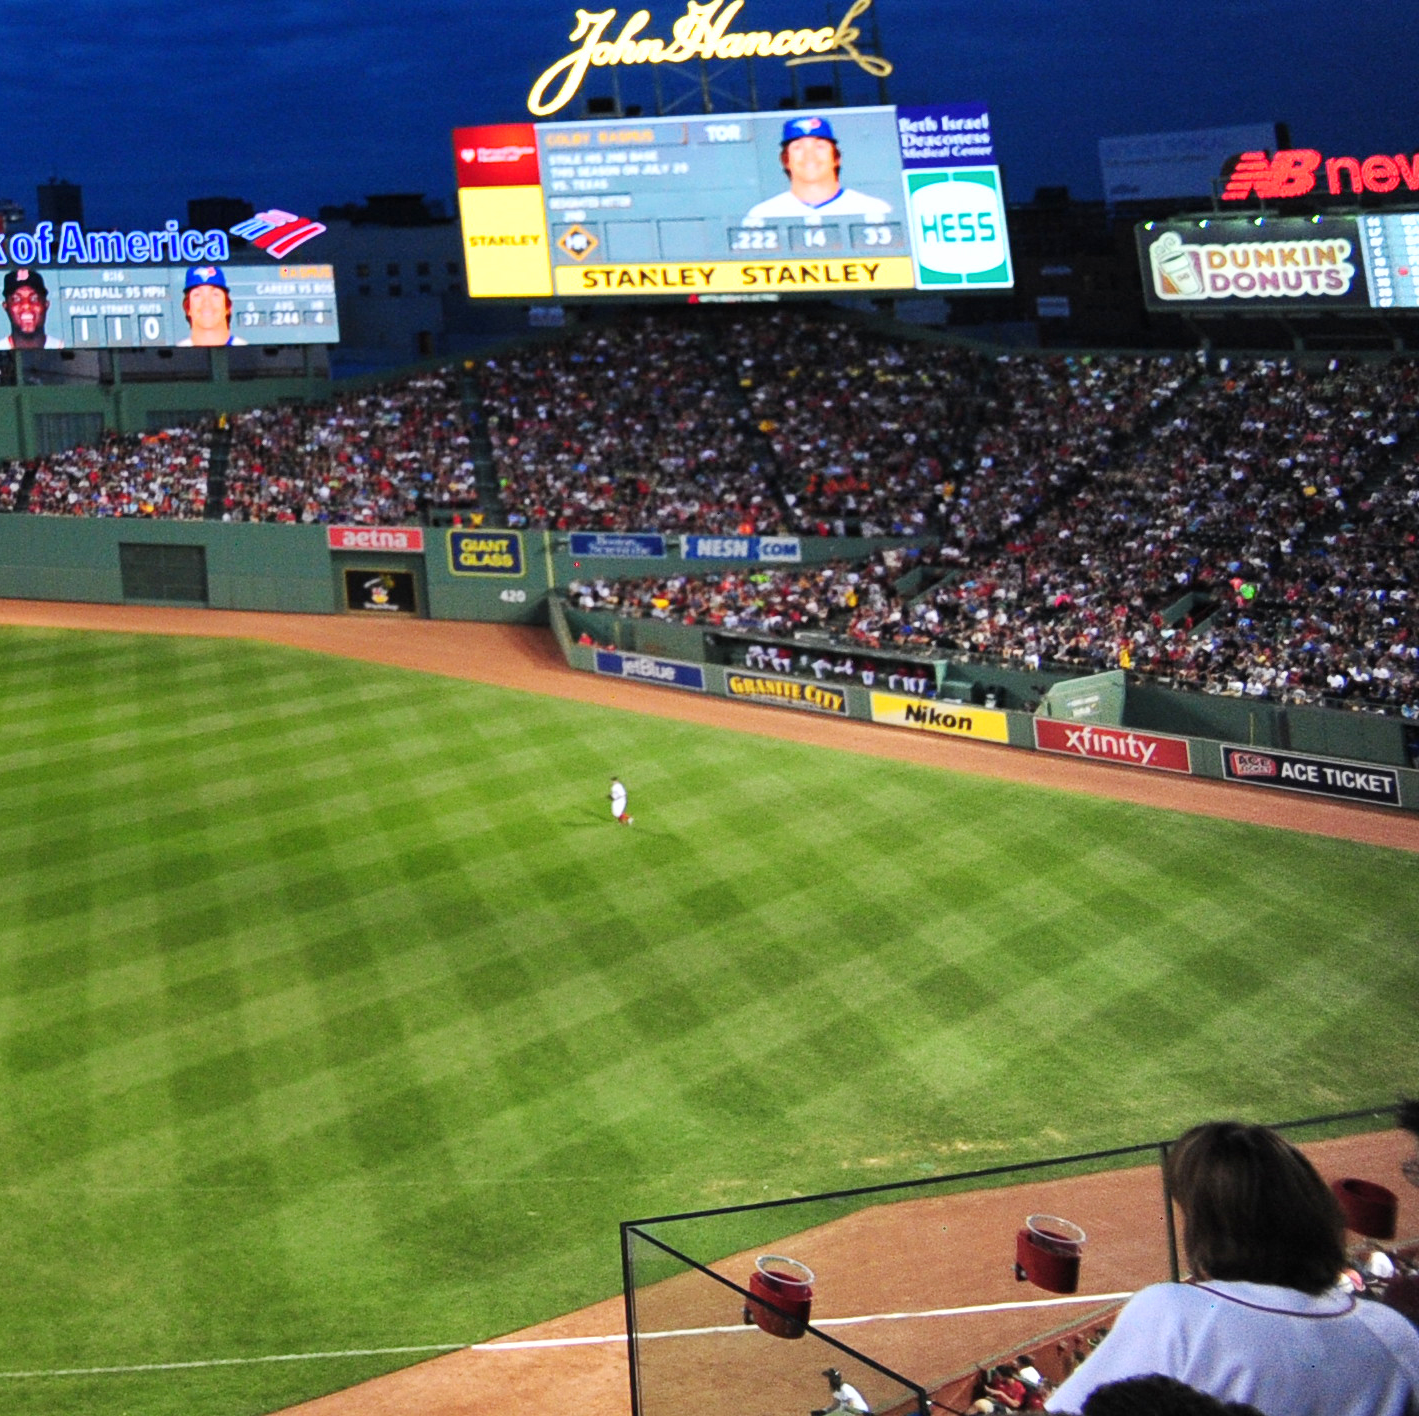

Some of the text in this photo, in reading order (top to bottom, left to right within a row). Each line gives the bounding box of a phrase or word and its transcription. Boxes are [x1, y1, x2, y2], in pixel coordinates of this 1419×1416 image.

[528, 9, 664, 115] John
[899, 113, 989, 132] Beth Israel
[705, 124, 741, 142] TOR
[901, 133, 990, 148] Deaconess
[902, 146, 950, 158] Medical
[921, 212, 995, 242] HESS
[9, 222, 53, 265] of
[57, 221, 230, 263] America
[470, 235, 540, 247] STANLEY
[732, 227, 891, 250] .222 14 33
[1207, 244, 1345, 269] DUNKIN'
[583, 263, 880, 288] STANLEY STANLEY
[1209, 269, 1343, 292] DONUTS
[65, 286, 166, 300] FASTBALL 95 MPH
[256, 285, 295, 295] CAREER
[69, 304, 161, 314] BALLS STRIKES OUTS
[244, 313, 324, 325] 37 .244 4
[81, 316, 160, 341] 1 1 0
[343, 528, 407, 549] aetna
[461, 539, 509, 554] GIANT
[697, 538, 748, 557] NESN
[459, 552, 513, 568] GLASS
[499, 589, 526, 602] 420
[622, 657, 676, 681] jetBlue
[730, 676, 801, 700] GRANITE
[805, 685, 844, 712] CITY
[905, 702, 972, 732] Nikon
[1065, 728, 1157, 764] xfinity
[1239, 755, 1271, 766] ACE
[1281, 762, 1393, 794] ACE TICKET
